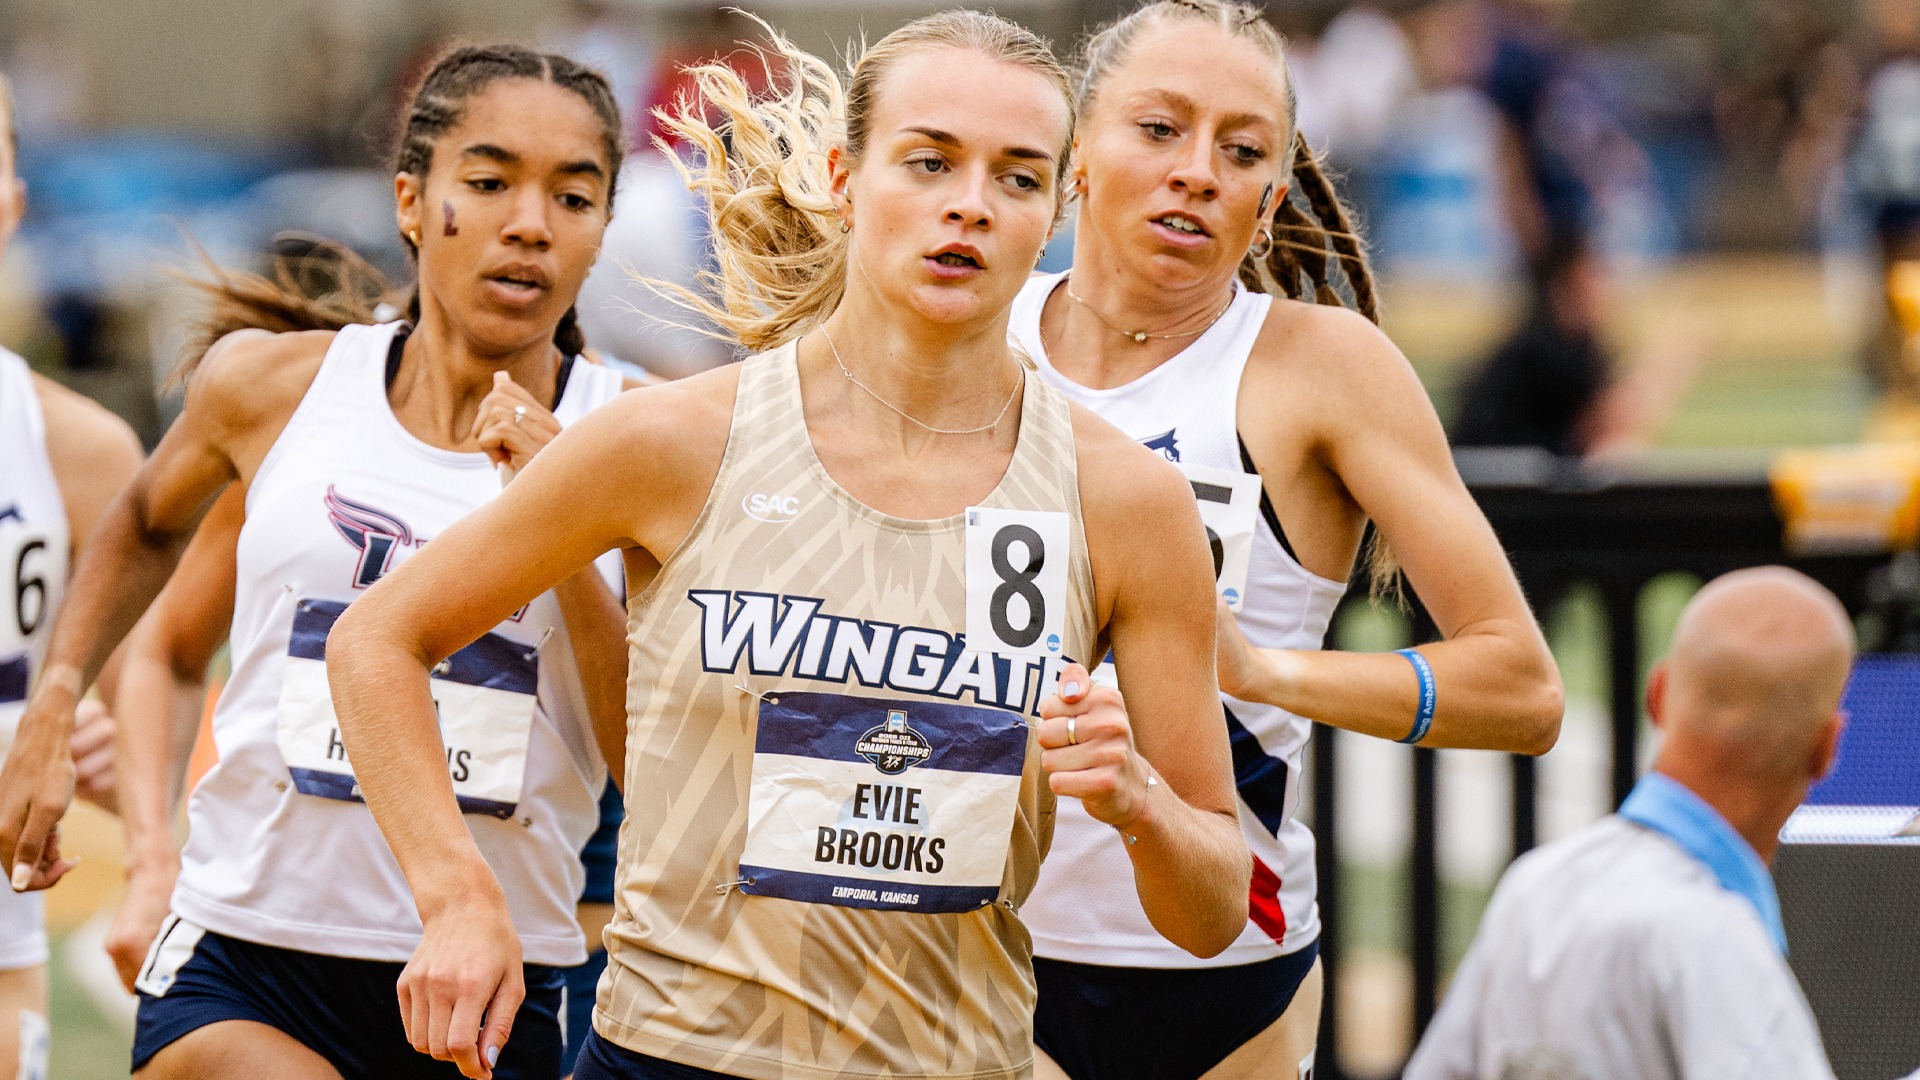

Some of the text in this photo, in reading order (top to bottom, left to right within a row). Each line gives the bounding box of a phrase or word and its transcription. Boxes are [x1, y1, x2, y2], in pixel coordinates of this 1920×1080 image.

[749, 493, 800, 516] SAC
[16, 540, 46, 636] 6
[990, 524, 1046, 648] 8
[858, 742, 930, 758] CHAMPIONSHIPS
[852, 783, 922, 825] EVIE
[814, 825, 946, 874] BROOKS
[831, 886, 920, 905] EMPORIA, KANSAS
